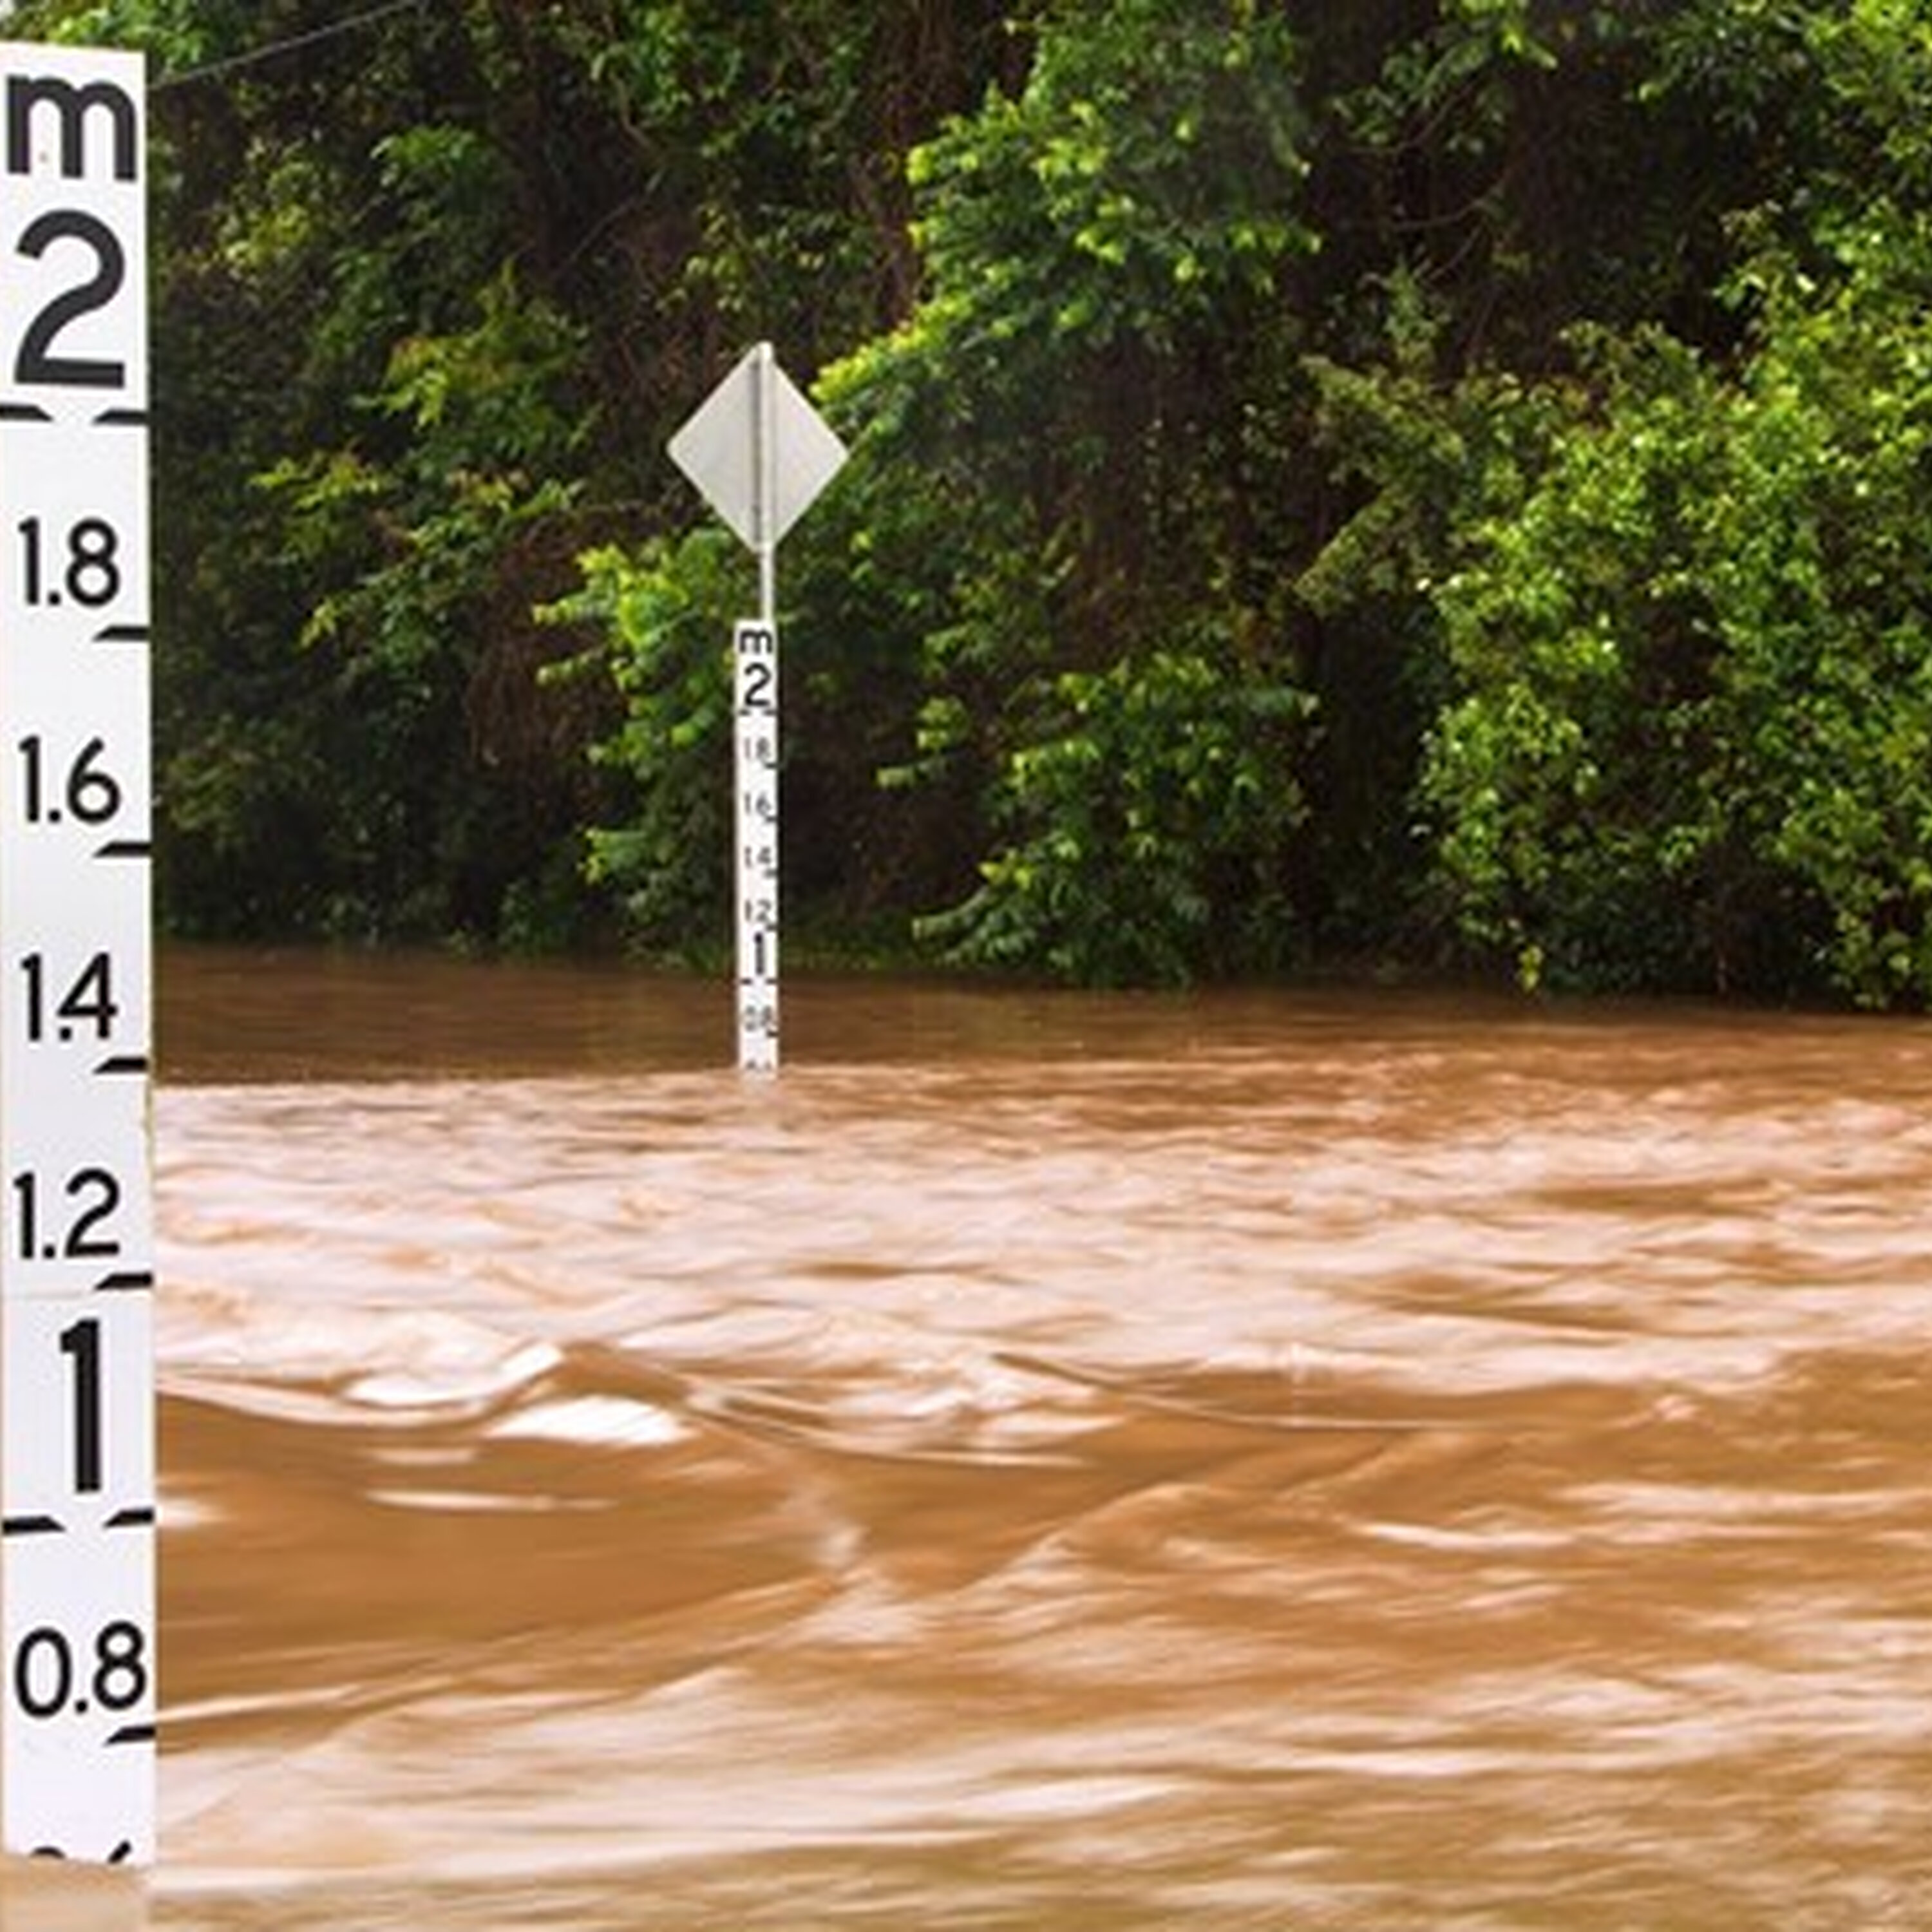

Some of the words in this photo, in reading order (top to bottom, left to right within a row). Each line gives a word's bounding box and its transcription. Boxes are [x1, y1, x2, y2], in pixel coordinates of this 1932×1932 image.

[8, 76, 136, 181] m
[15, 211, 124, 388] 2
[19, 518, 118, 607] 1.8
[739, 629, 772, 654] m
[744, 662, 772, 706] 2
[20, 737, 120, 824] 1.6
[22, 953, 117, 1041] 1.4
[753, 932, 766, 976] 1
[14, 1169, 119, 1258] 1.2
[61, 1320, 100, 1493] 1
[15, 1622, 146, 1717] 0.8
